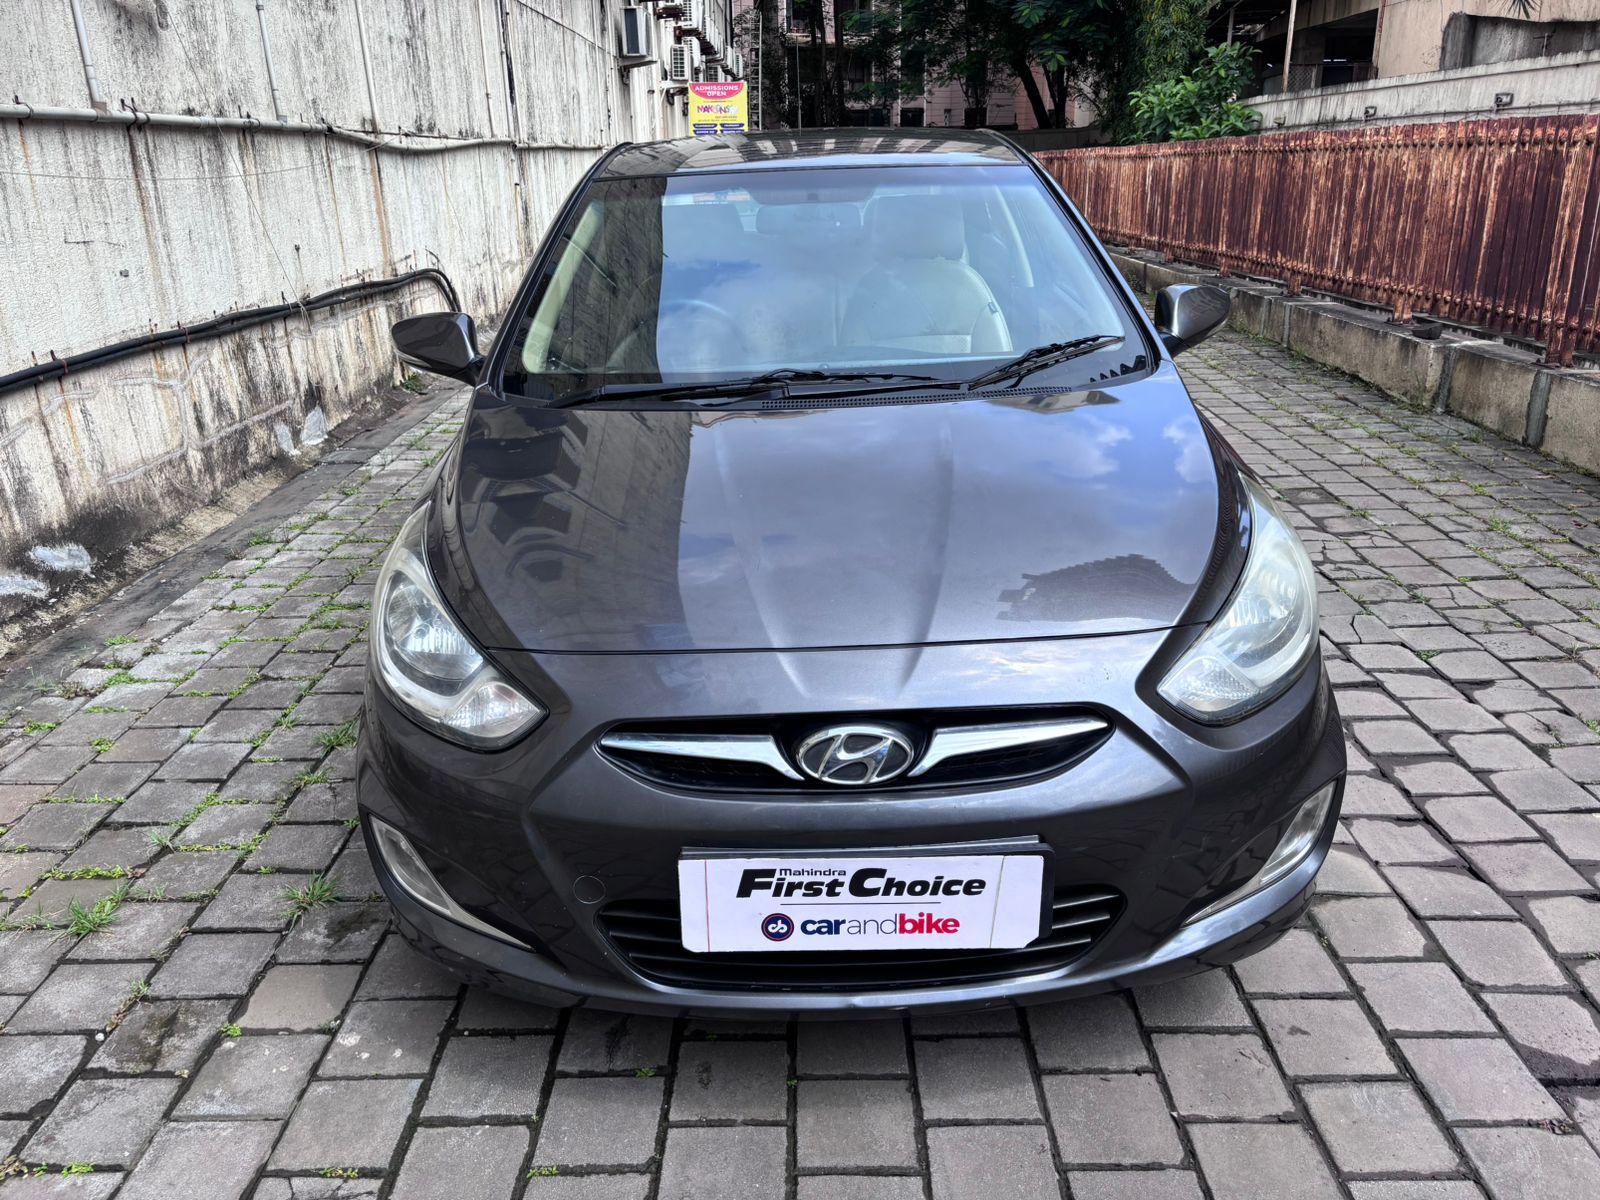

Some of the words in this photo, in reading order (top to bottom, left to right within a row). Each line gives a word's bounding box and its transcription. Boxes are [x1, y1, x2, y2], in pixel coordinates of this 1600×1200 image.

[736, 868, 845, 898] First
[849, 867, 986, 897] Choice
[779, 868, 846, 877] Mahindra
[800, 911, 960, 935] carandbike
